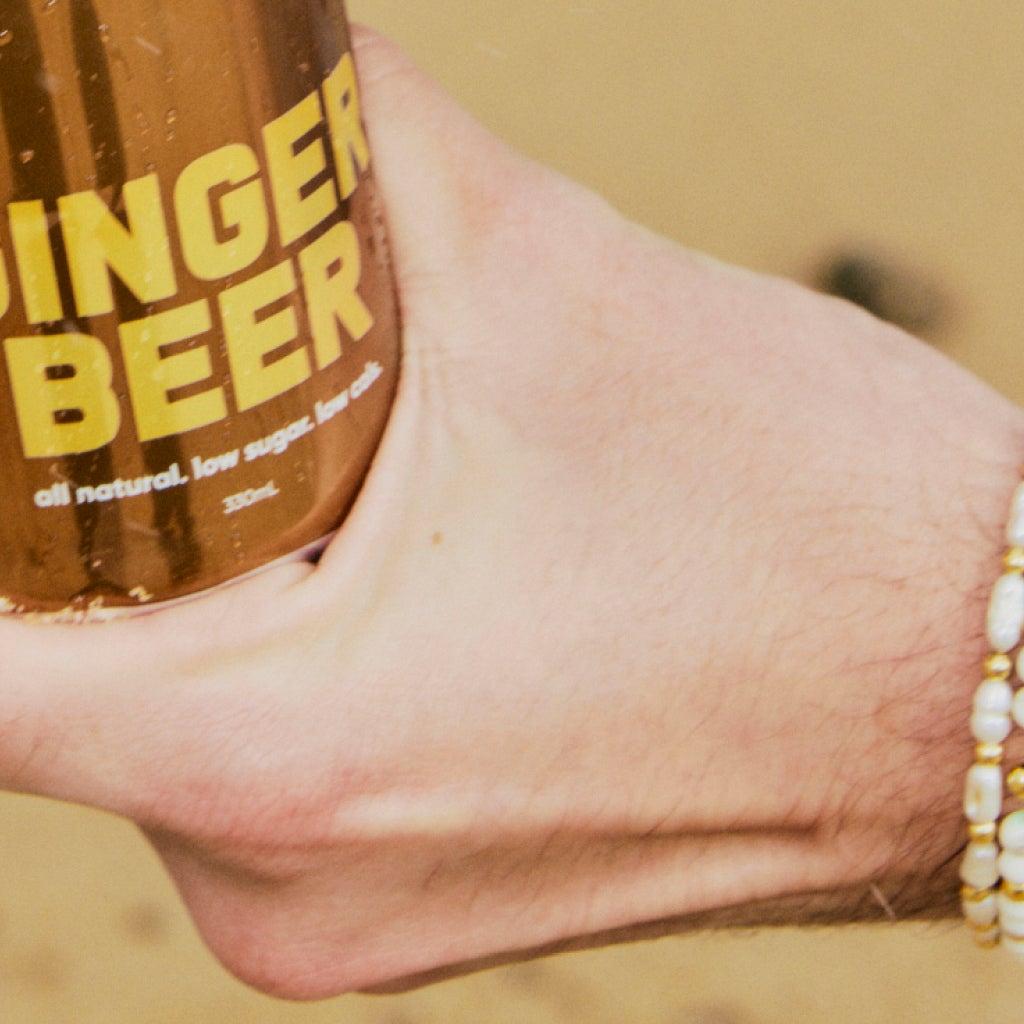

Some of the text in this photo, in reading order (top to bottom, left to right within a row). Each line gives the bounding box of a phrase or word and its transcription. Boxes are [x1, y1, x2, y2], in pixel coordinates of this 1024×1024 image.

[3, 220, 374, 459] BEER
[33, 482, 71, 508] all
[76, 462, 189, 506] natural.
[190, 447, 240, 481] low
[314, 388, 350, 425] low
